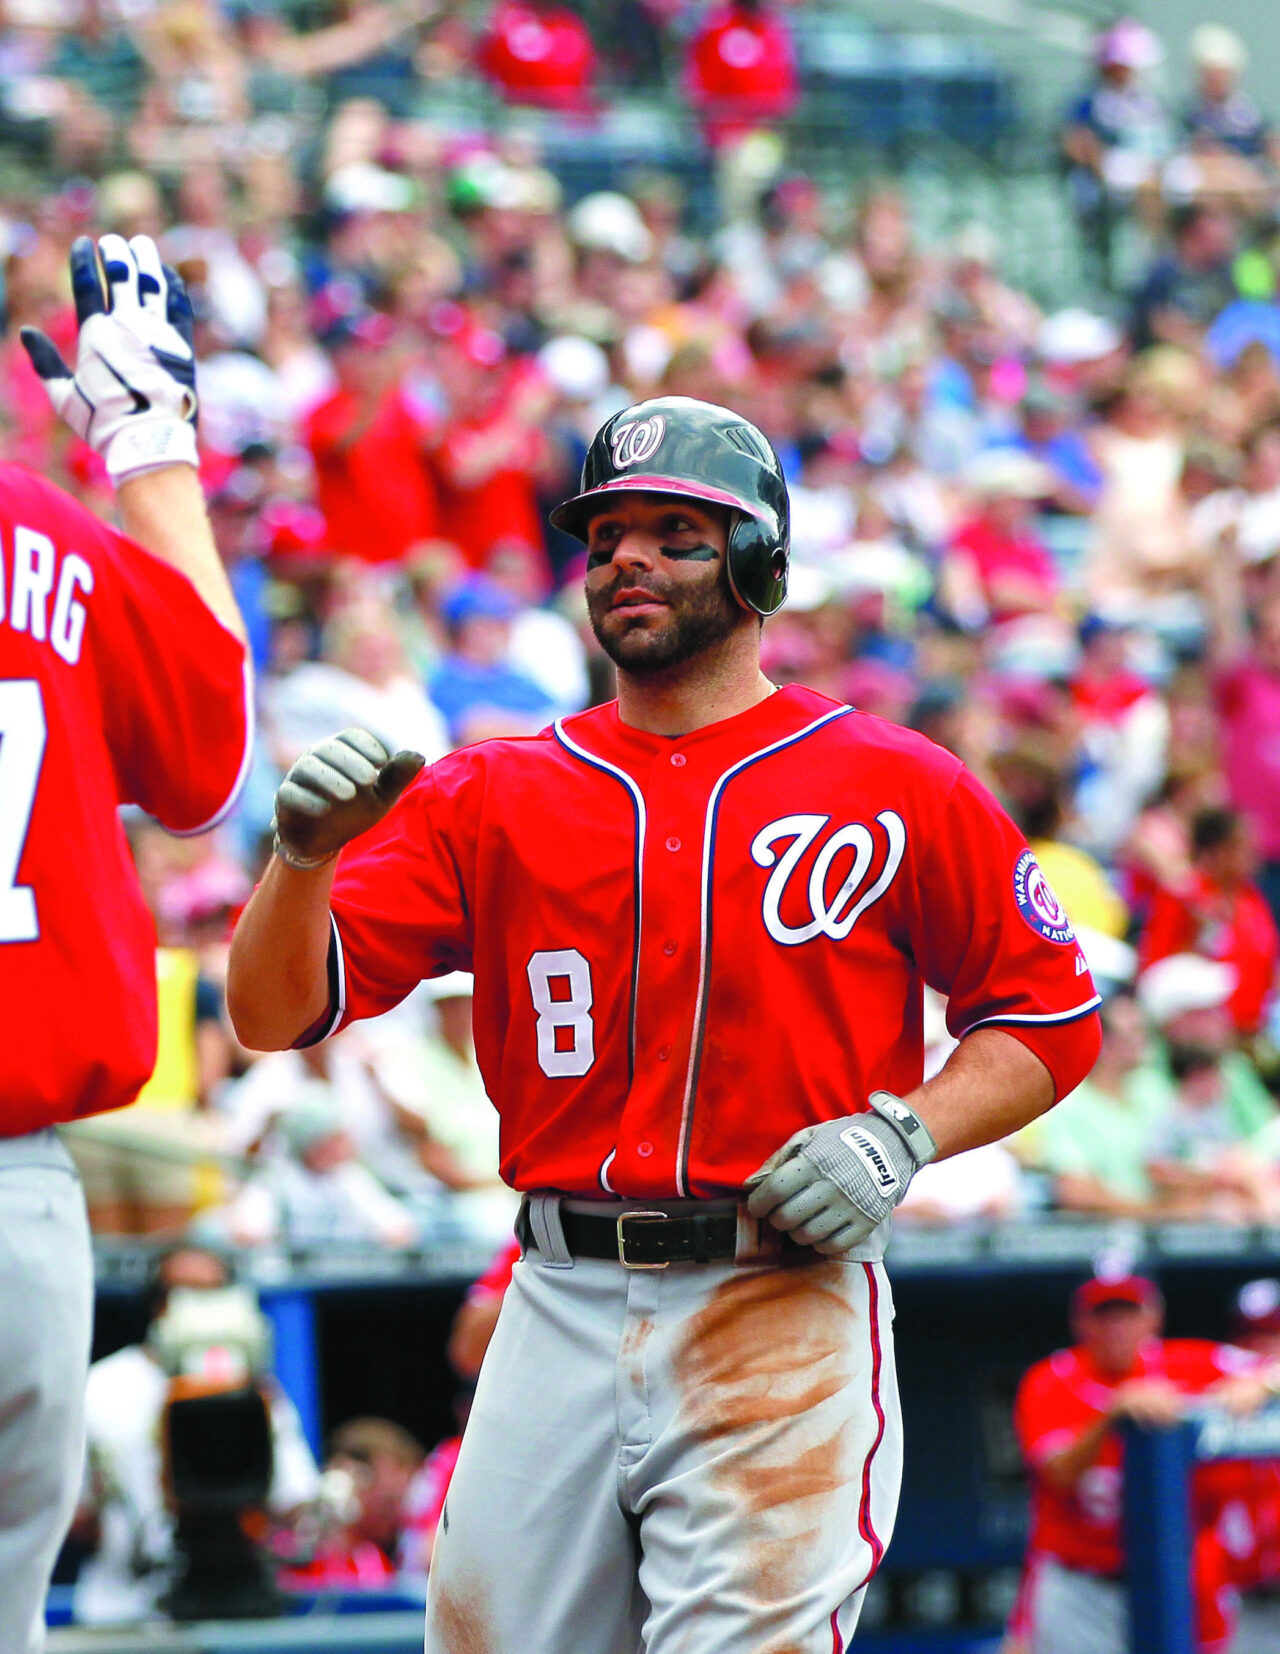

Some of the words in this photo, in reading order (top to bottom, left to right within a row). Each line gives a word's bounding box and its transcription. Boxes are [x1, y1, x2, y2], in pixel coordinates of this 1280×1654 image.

[611, 414, 666, 470] W
[750, 809, 907, 946] W
[525, 948, 596, 1079] 8
[850, 1132, 896, 1187] franklin
